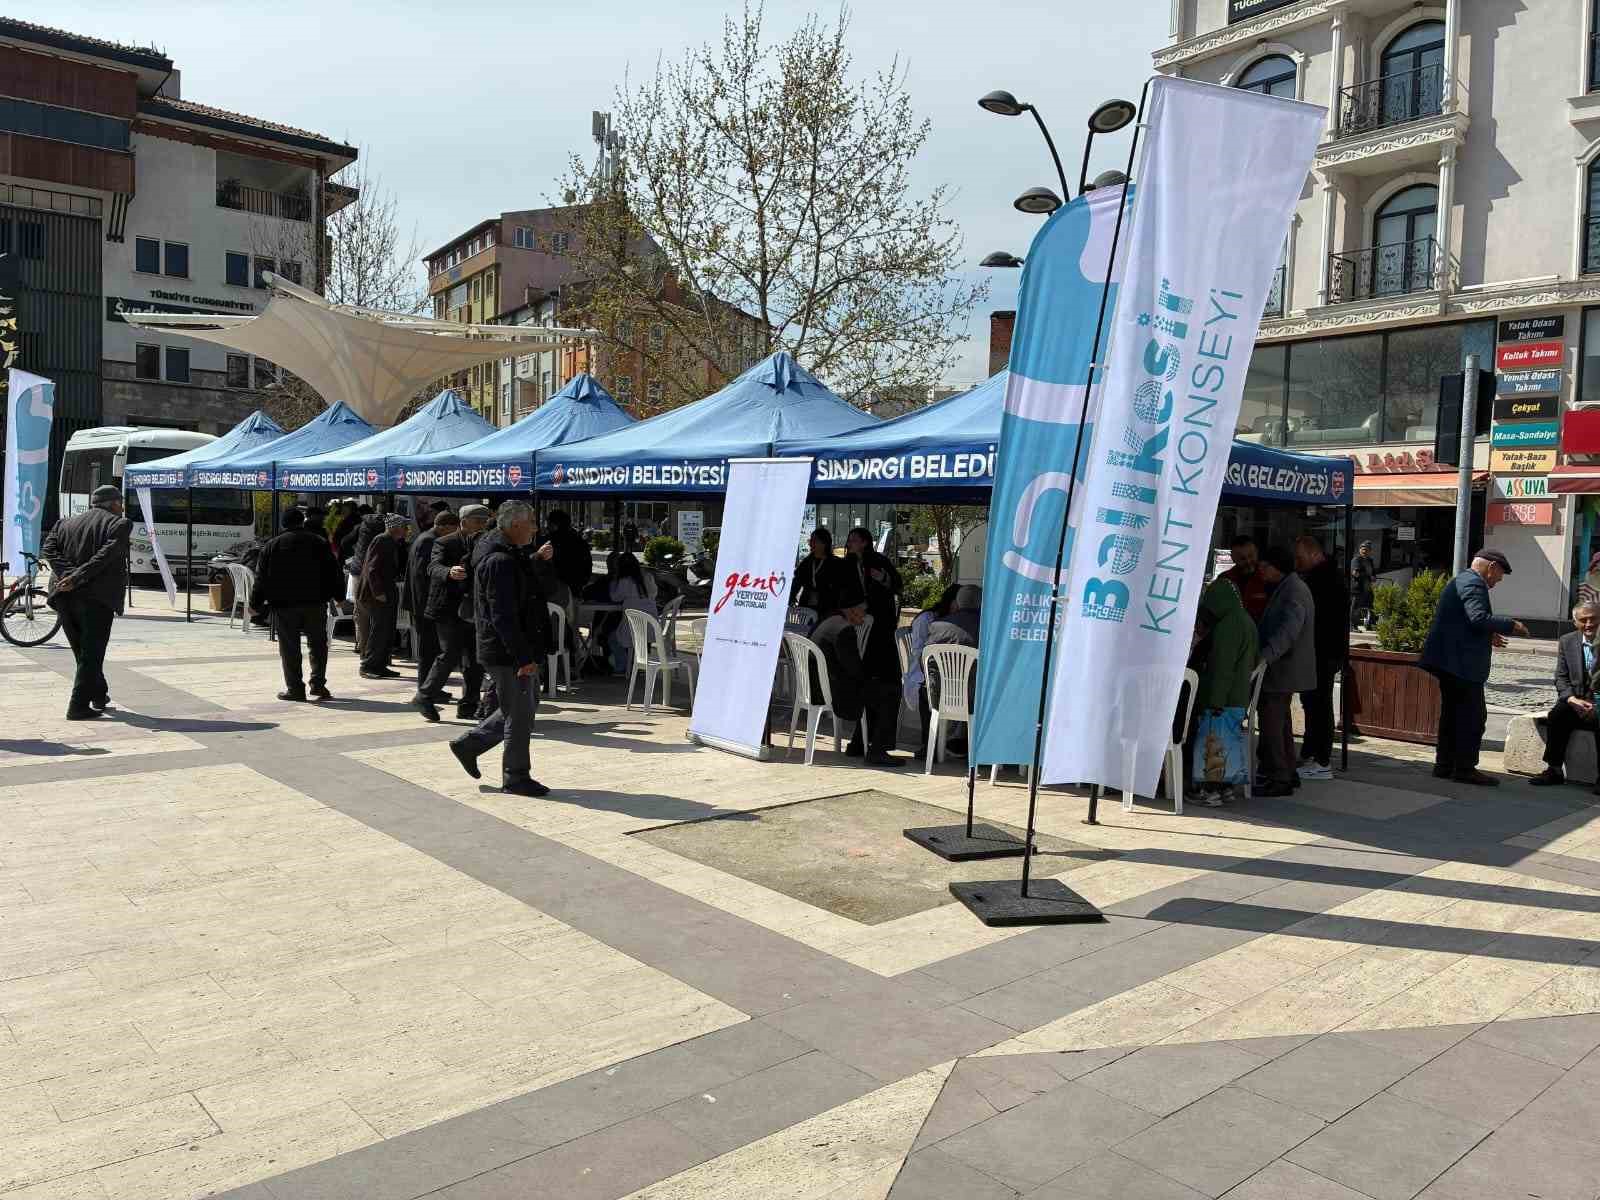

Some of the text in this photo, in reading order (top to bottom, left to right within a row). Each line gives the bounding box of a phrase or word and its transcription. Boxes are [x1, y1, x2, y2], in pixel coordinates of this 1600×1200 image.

[1503, 351, 1529, 360] Koltuk
[1512, 403, 1541, 414] Çekyat
[567, 459, 725, 486] SINDIRGI BELEDİYESİ
[815, 445, 998, 481] SINDIRGI BELEDİ
[1140, 288, 1243, 635] KENT KONSEYİ
[289, 468, 366, 488] SINDIRGI BELEDİYESİ
[405, 464, 506, 487] SINDIRGI BELEDİYESİ
[1248, 464, 1329, 496] BELEDİYESİ
[1506, 479, 1546, 496] ASSUVA
